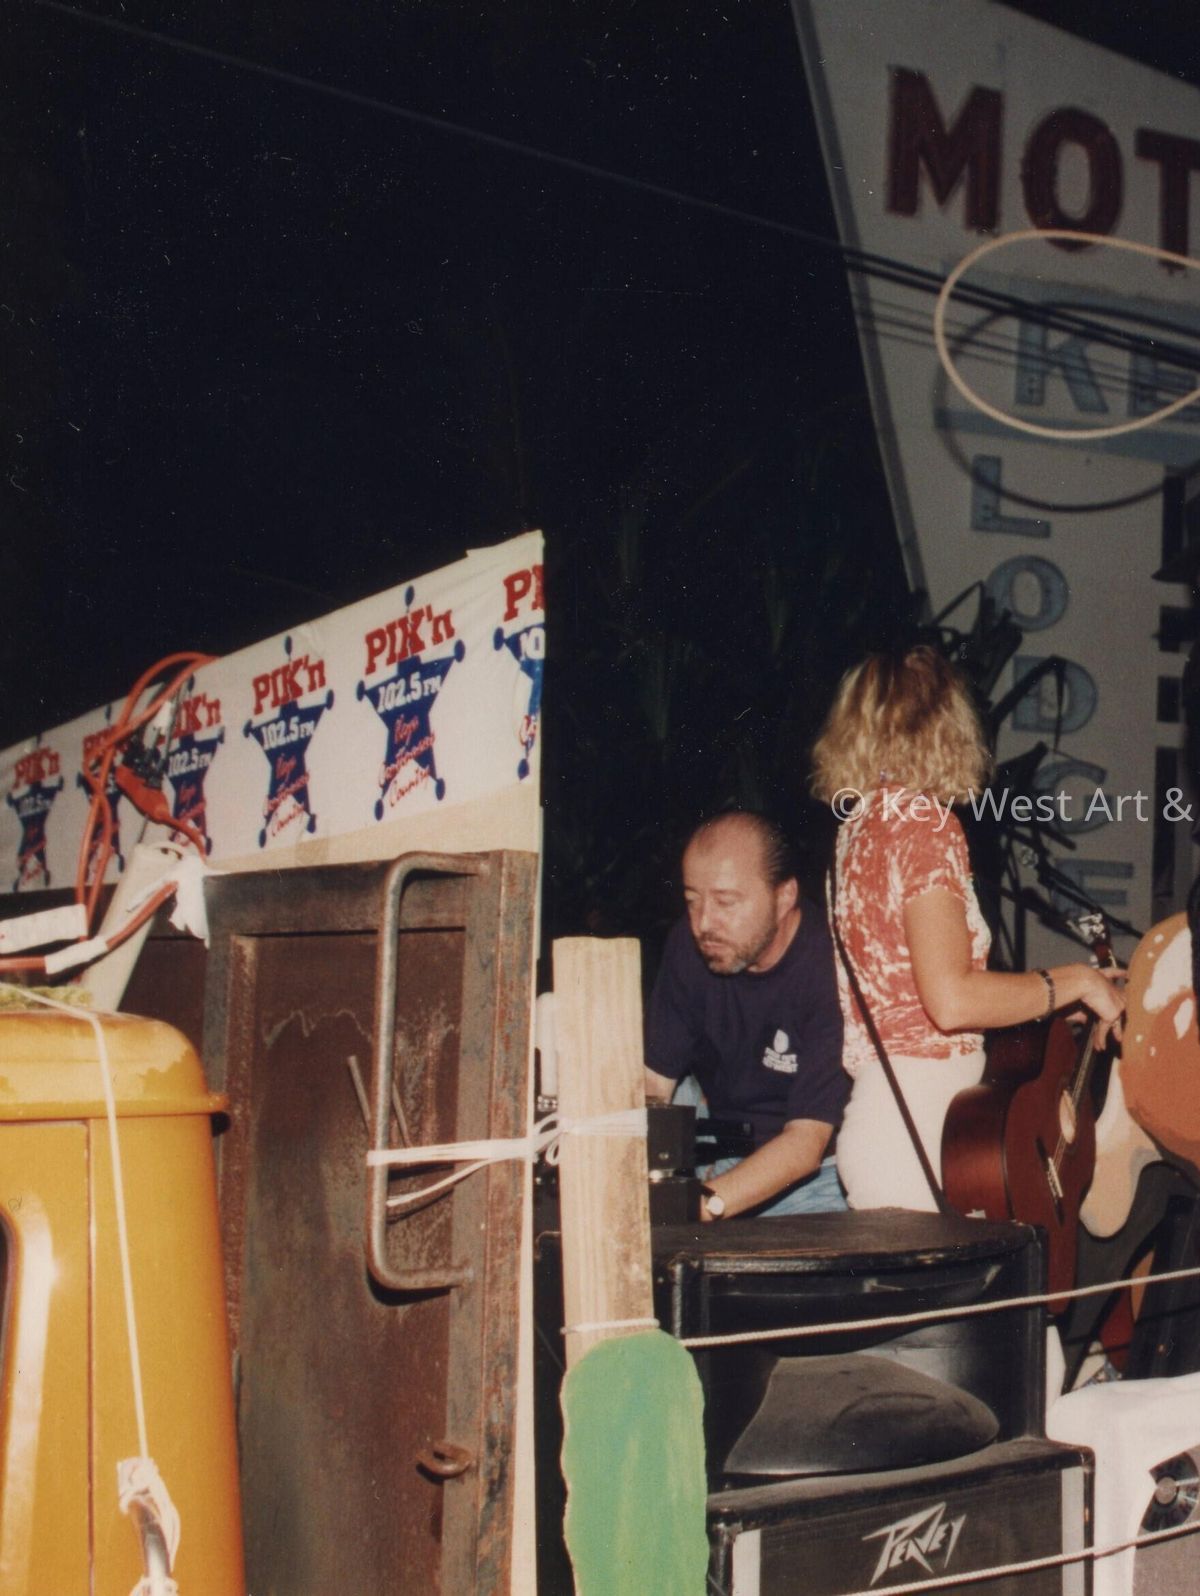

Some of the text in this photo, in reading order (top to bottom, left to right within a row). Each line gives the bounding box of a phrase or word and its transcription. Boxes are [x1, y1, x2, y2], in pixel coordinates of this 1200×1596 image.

[365, 605, 455, 675] PIK'n
[252, 654, 326, 715] PIK'n
[971, 453, 1134, 928] LODGE
